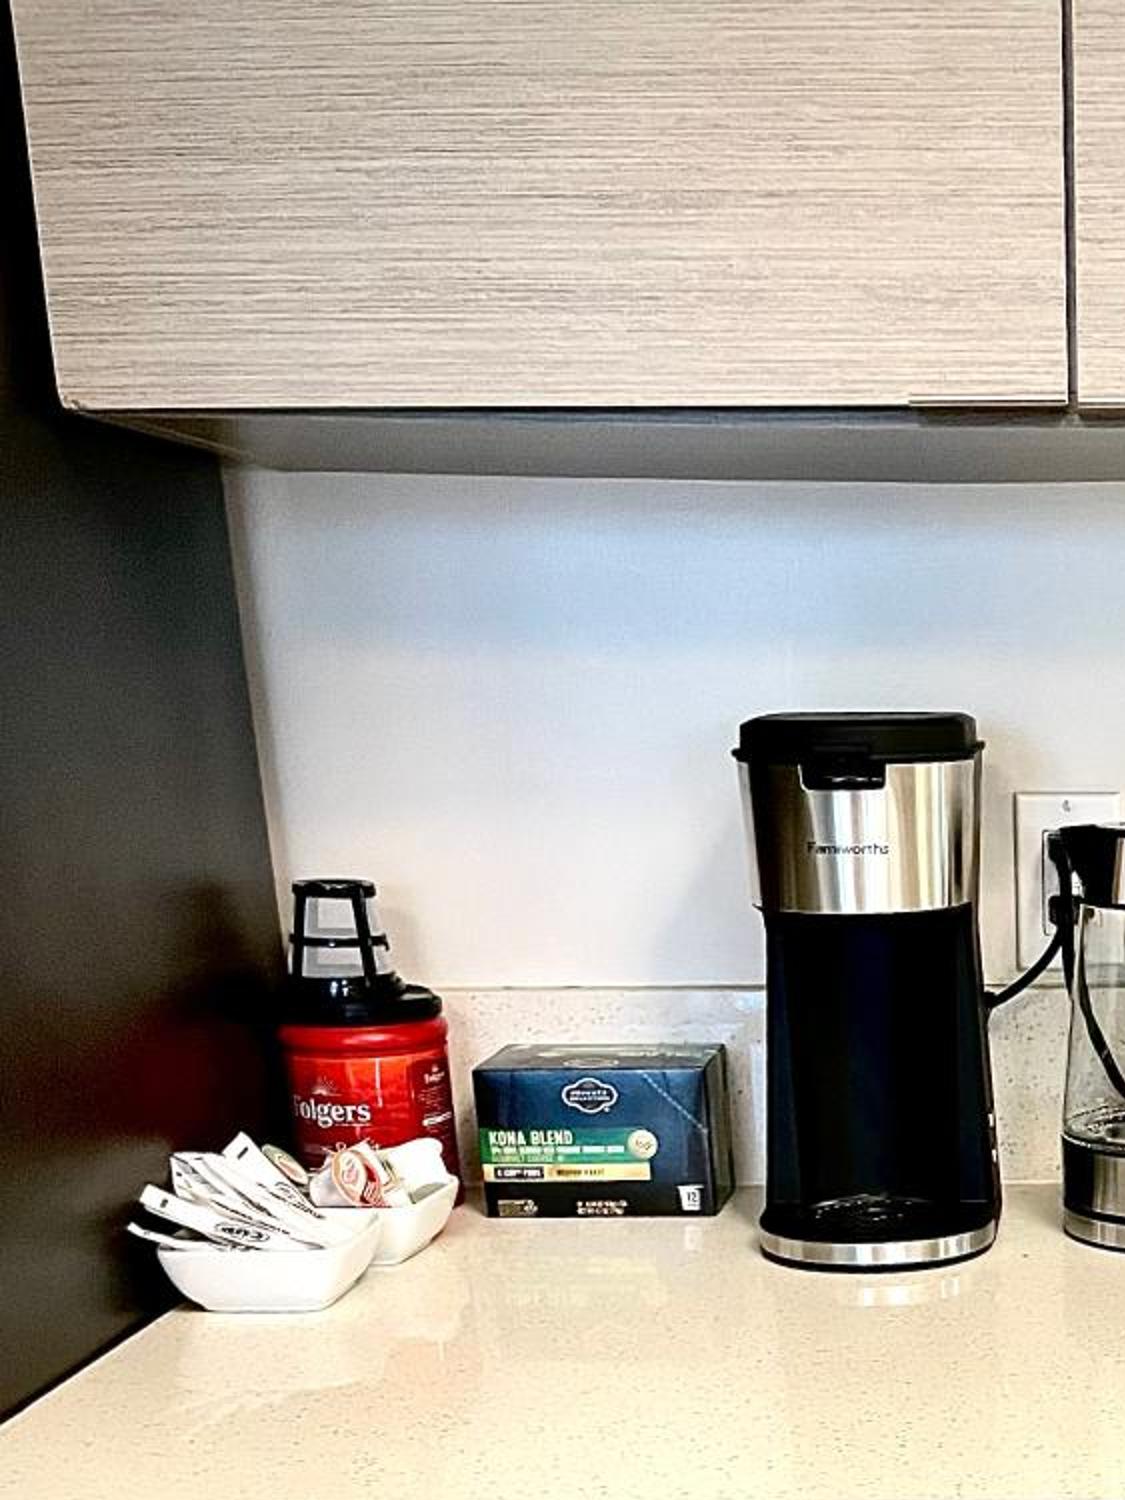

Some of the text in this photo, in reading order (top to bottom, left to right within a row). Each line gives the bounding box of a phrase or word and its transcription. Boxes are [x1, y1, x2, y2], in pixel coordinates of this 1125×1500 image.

[489, 1129, 573, 1145] KONA BLEND
[687, 1191, 697, 1201] 12
